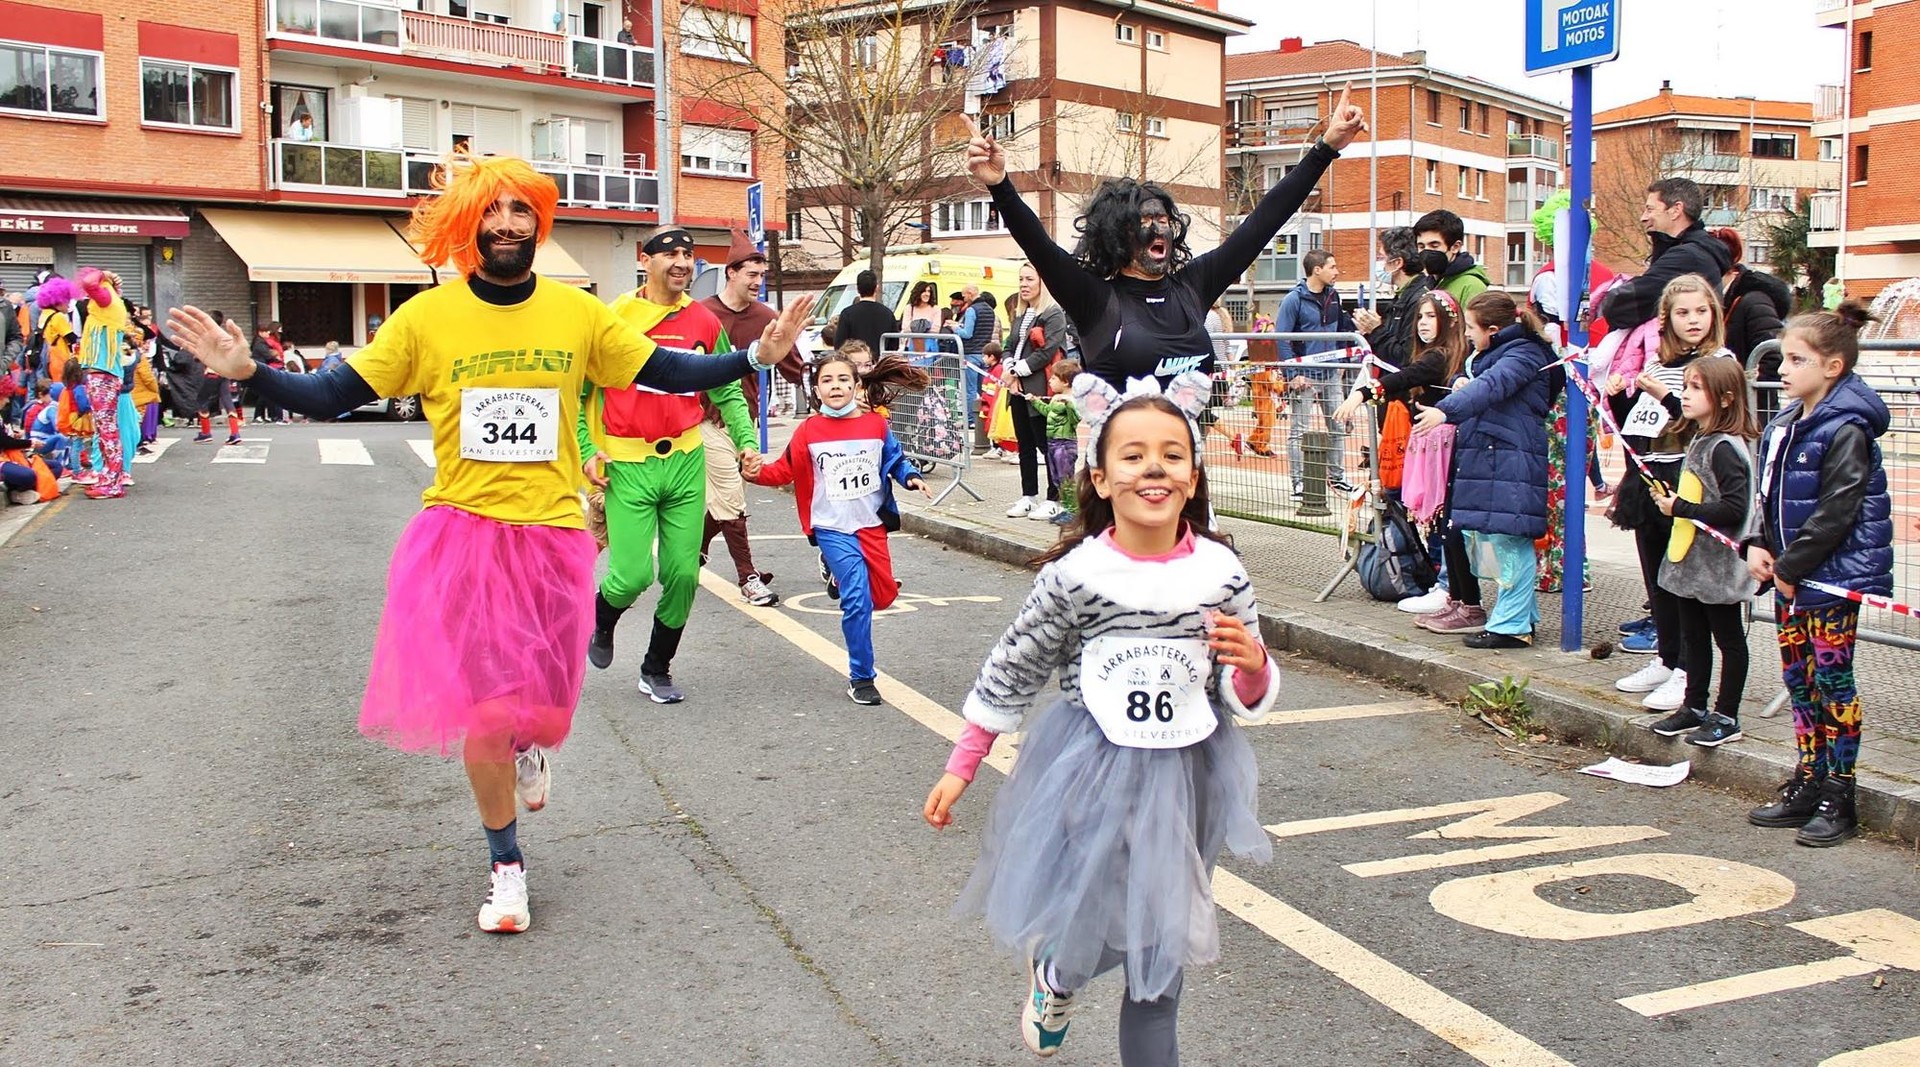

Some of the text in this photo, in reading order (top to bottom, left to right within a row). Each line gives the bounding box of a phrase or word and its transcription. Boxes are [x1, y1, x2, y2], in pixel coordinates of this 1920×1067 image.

[1562, 2, 1609, 27] MOTOAK
[1565, 25, 1605, 47] MOTOS
[71, 222, 139, 234] TABERNA
[450, 348, 574, 383] HIRUBI
[471, 392, 549, 418] LARRABASTERRAKO
[1632, 409, 1660, 426] 349
[482, 422, 538, 445] 344
[462, 446, 554, 456] SAN SILVESTREA
[839, 473, 870, 491] 116
[1098, 645, 1198, 684] LARRABASTERRAKO
[1126, 690, 1174, 723] 86
